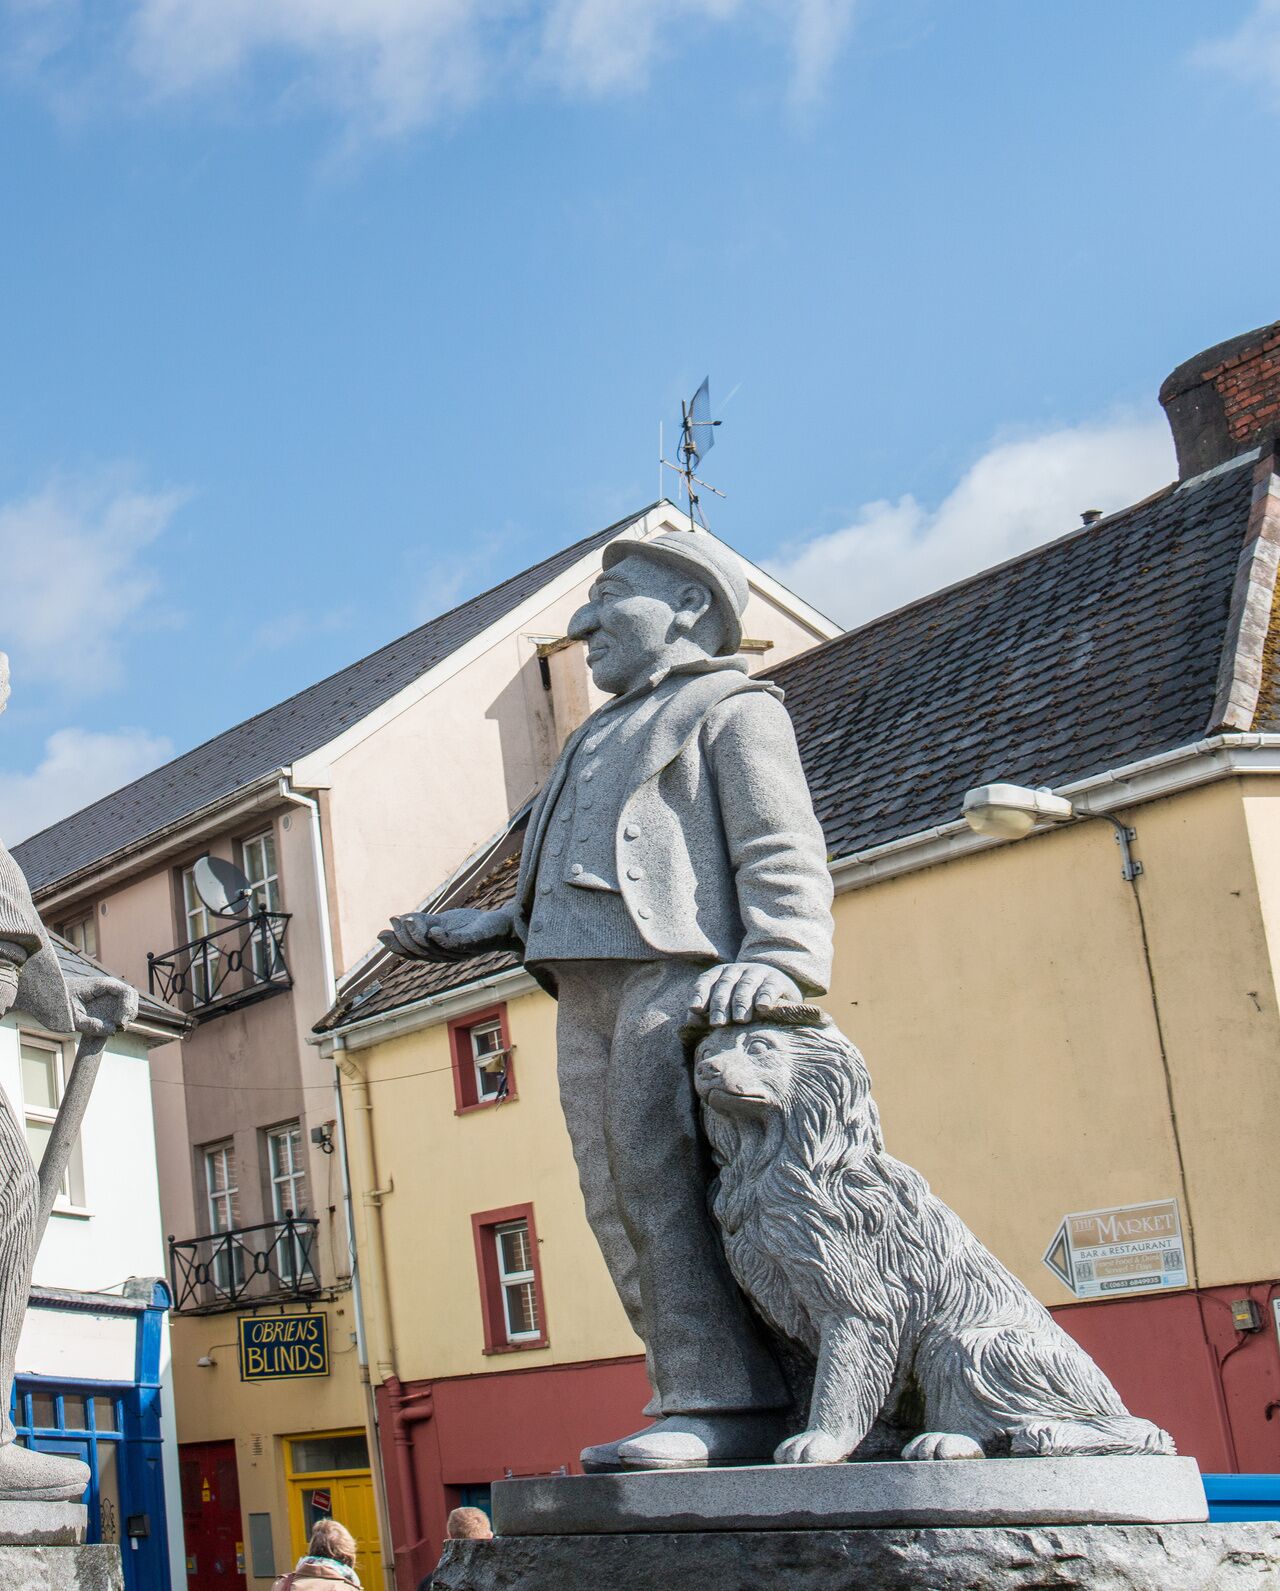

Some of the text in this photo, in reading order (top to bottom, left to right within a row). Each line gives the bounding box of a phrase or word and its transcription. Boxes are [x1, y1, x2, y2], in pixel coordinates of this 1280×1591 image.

[1095, 1214, 1173, 1244] MARKET
[1080, 1249, 1099, 1259] BAR
[1109, 1239, 1172, 1256] RESTAURANT
[247, 1343, 324, 1374] BLINDS
